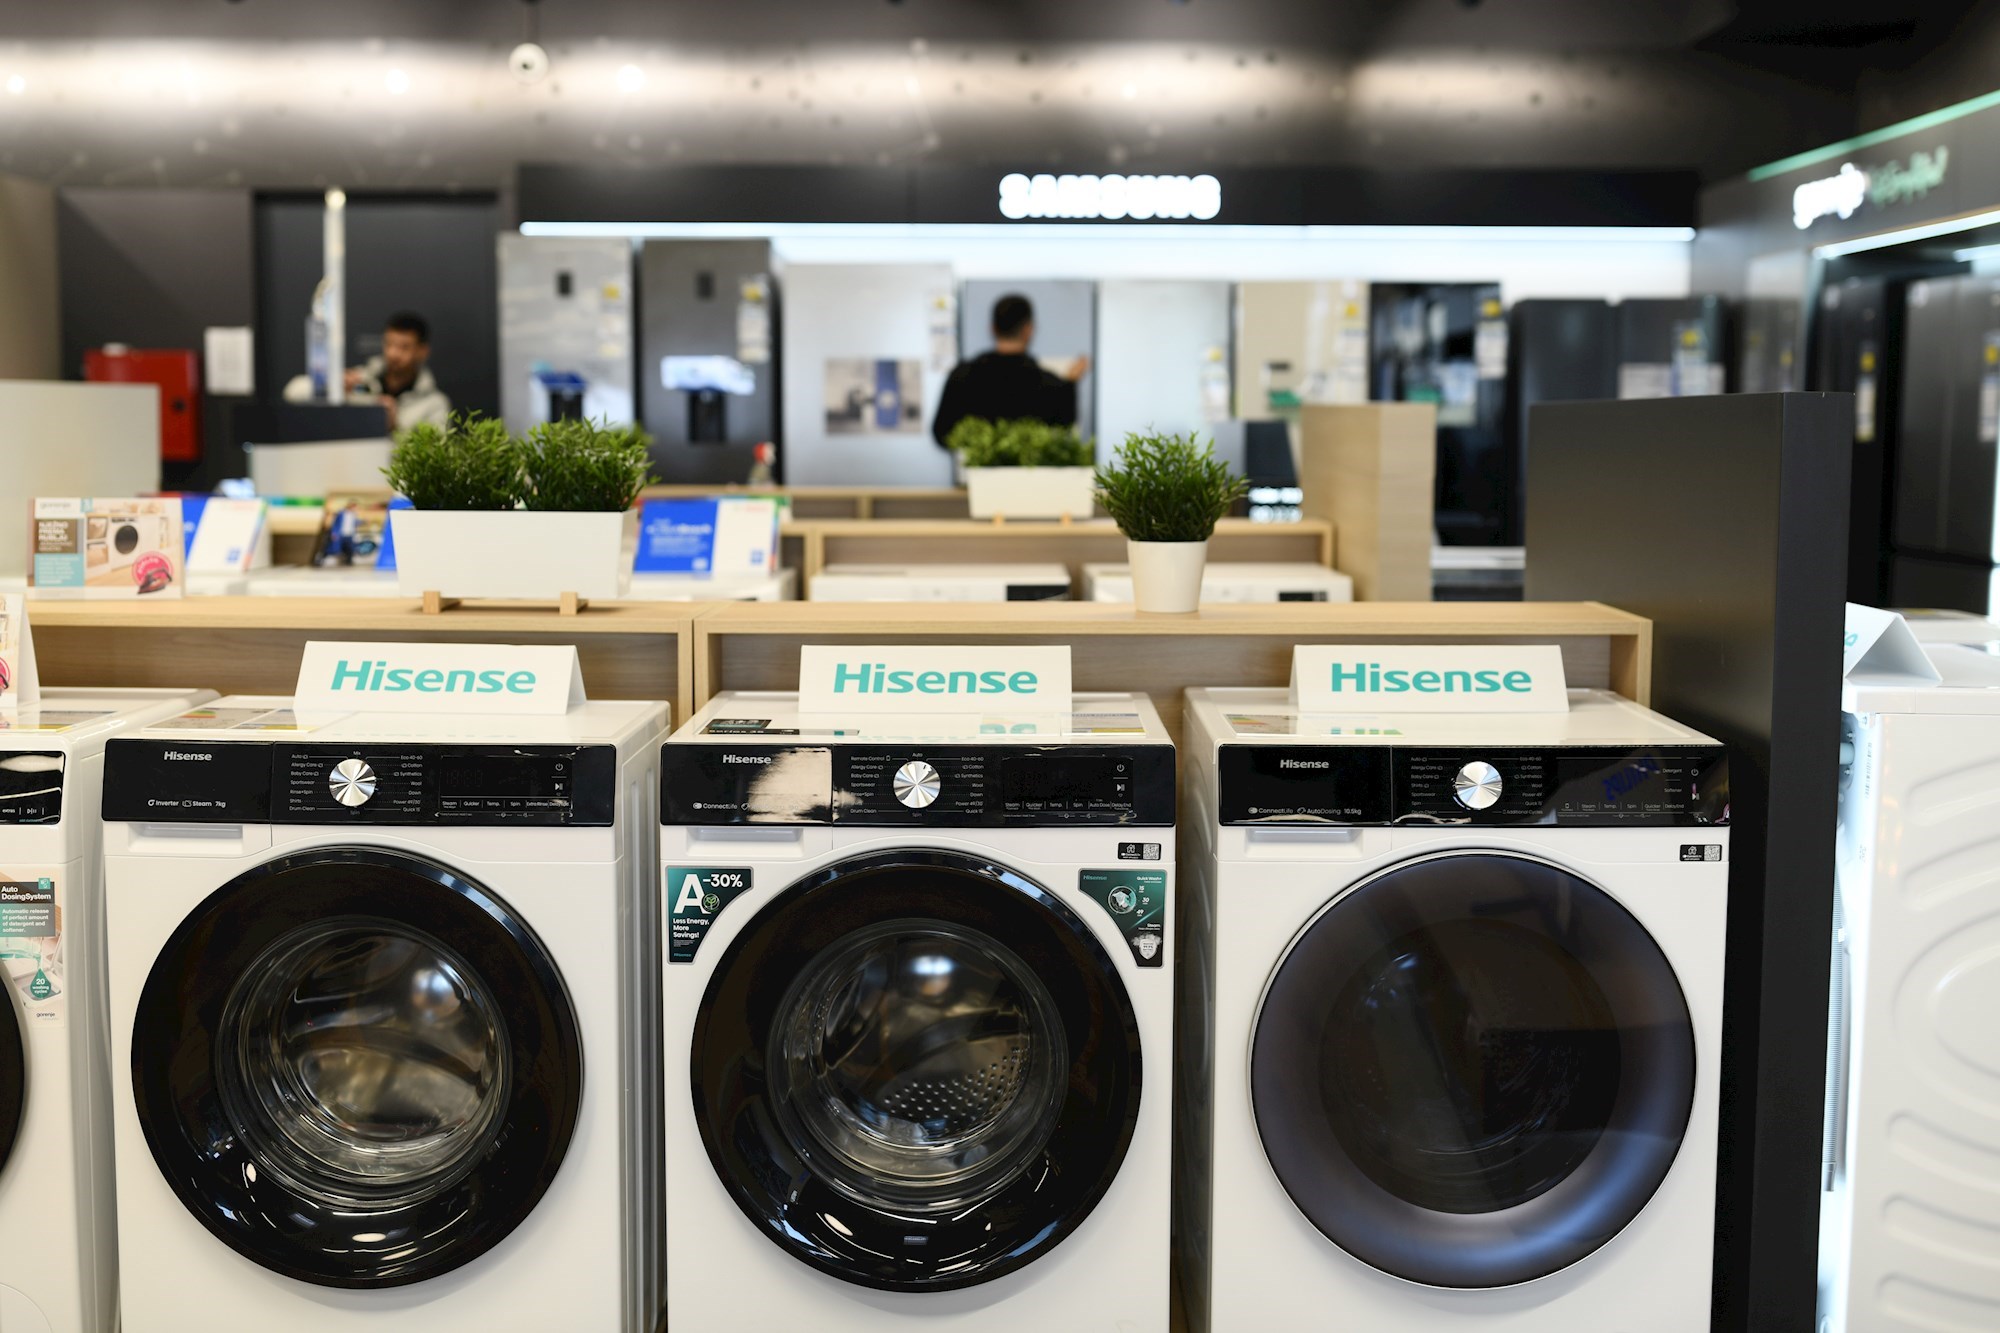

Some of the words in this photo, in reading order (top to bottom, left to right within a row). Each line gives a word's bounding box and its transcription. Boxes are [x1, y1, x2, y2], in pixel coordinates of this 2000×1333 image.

[330, 660, 536, 694] Hisense
[834, 663, 1038, 694] Hisense
[1332, 662, 1532, 692] Hisense
[164, 751, 212, 761] Hisense
[722, 754, 772, 764] Hisense
[1280, 759, 1329, 769] Hisense
[703, 874, 743, 888] -30%
[1, 893, 51, 901] DosingSystem
[673, 874, 712, 914] A
